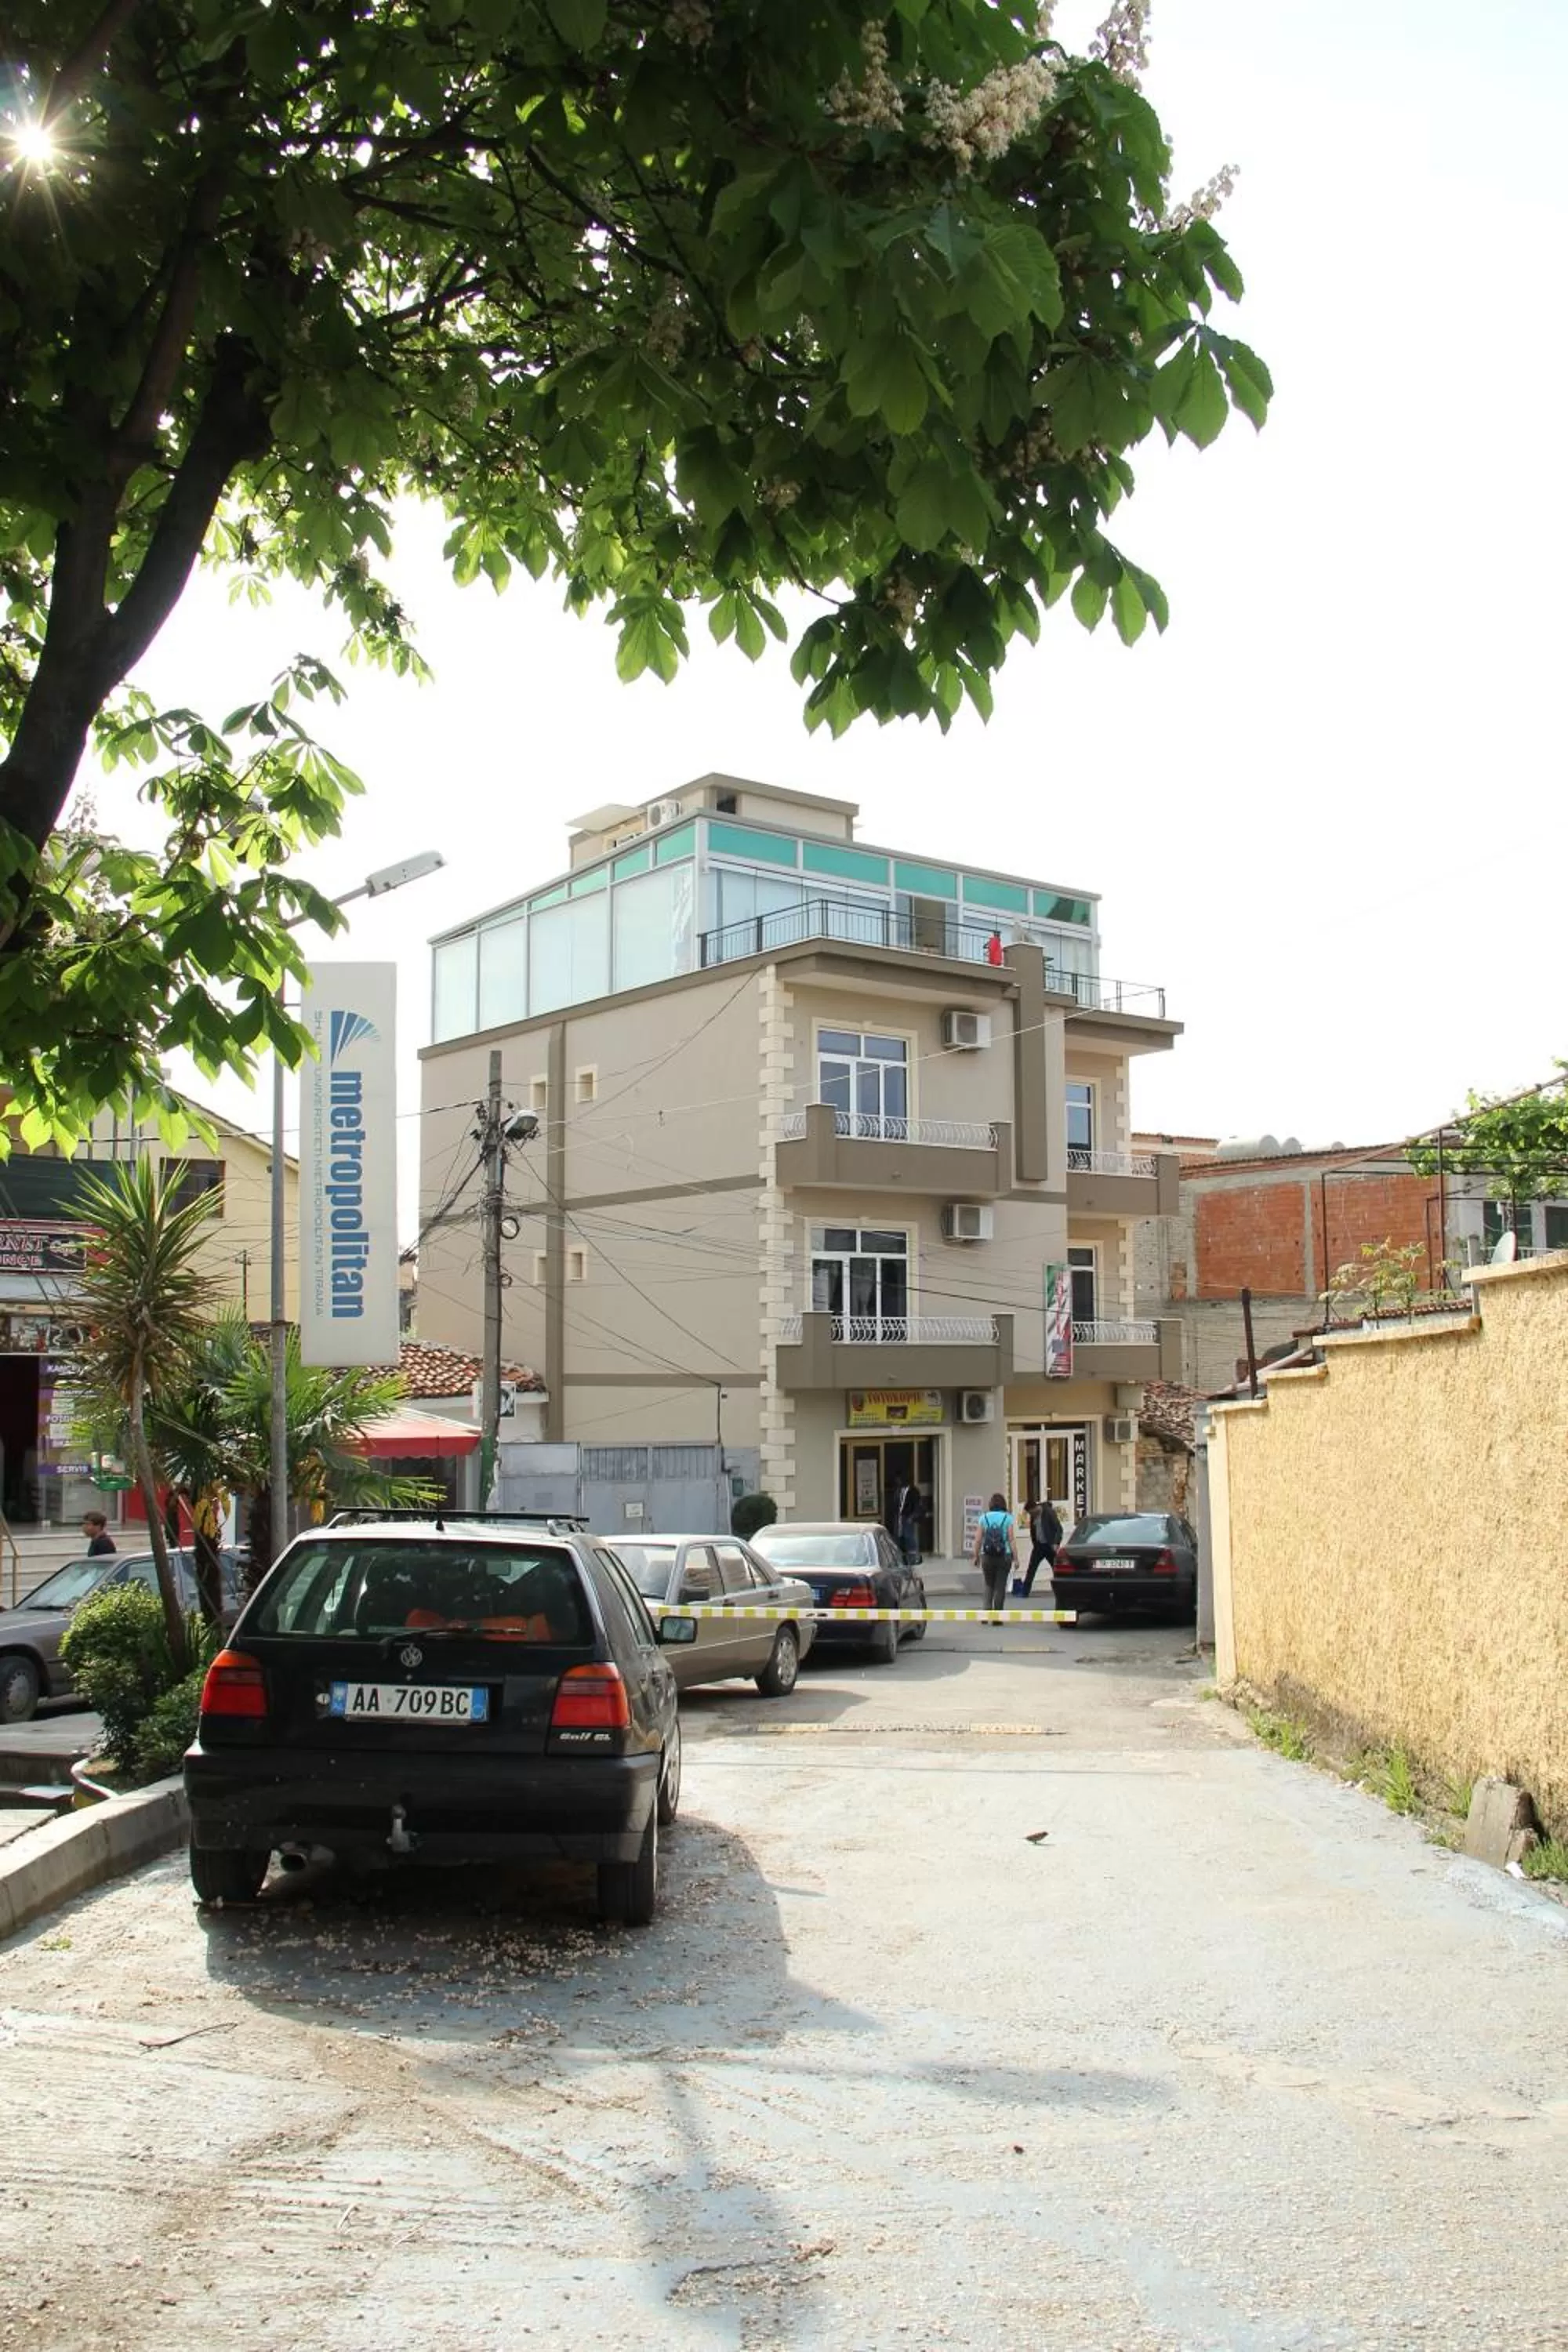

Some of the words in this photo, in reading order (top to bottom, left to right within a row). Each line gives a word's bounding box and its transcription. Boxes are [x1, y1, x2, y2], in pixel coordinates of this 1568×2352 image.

[326, 1071, 369, 1318] metropolitan
[1075, 1440, 1085, 1518] MARKET
[352, 1687, 380, 1711] AA
